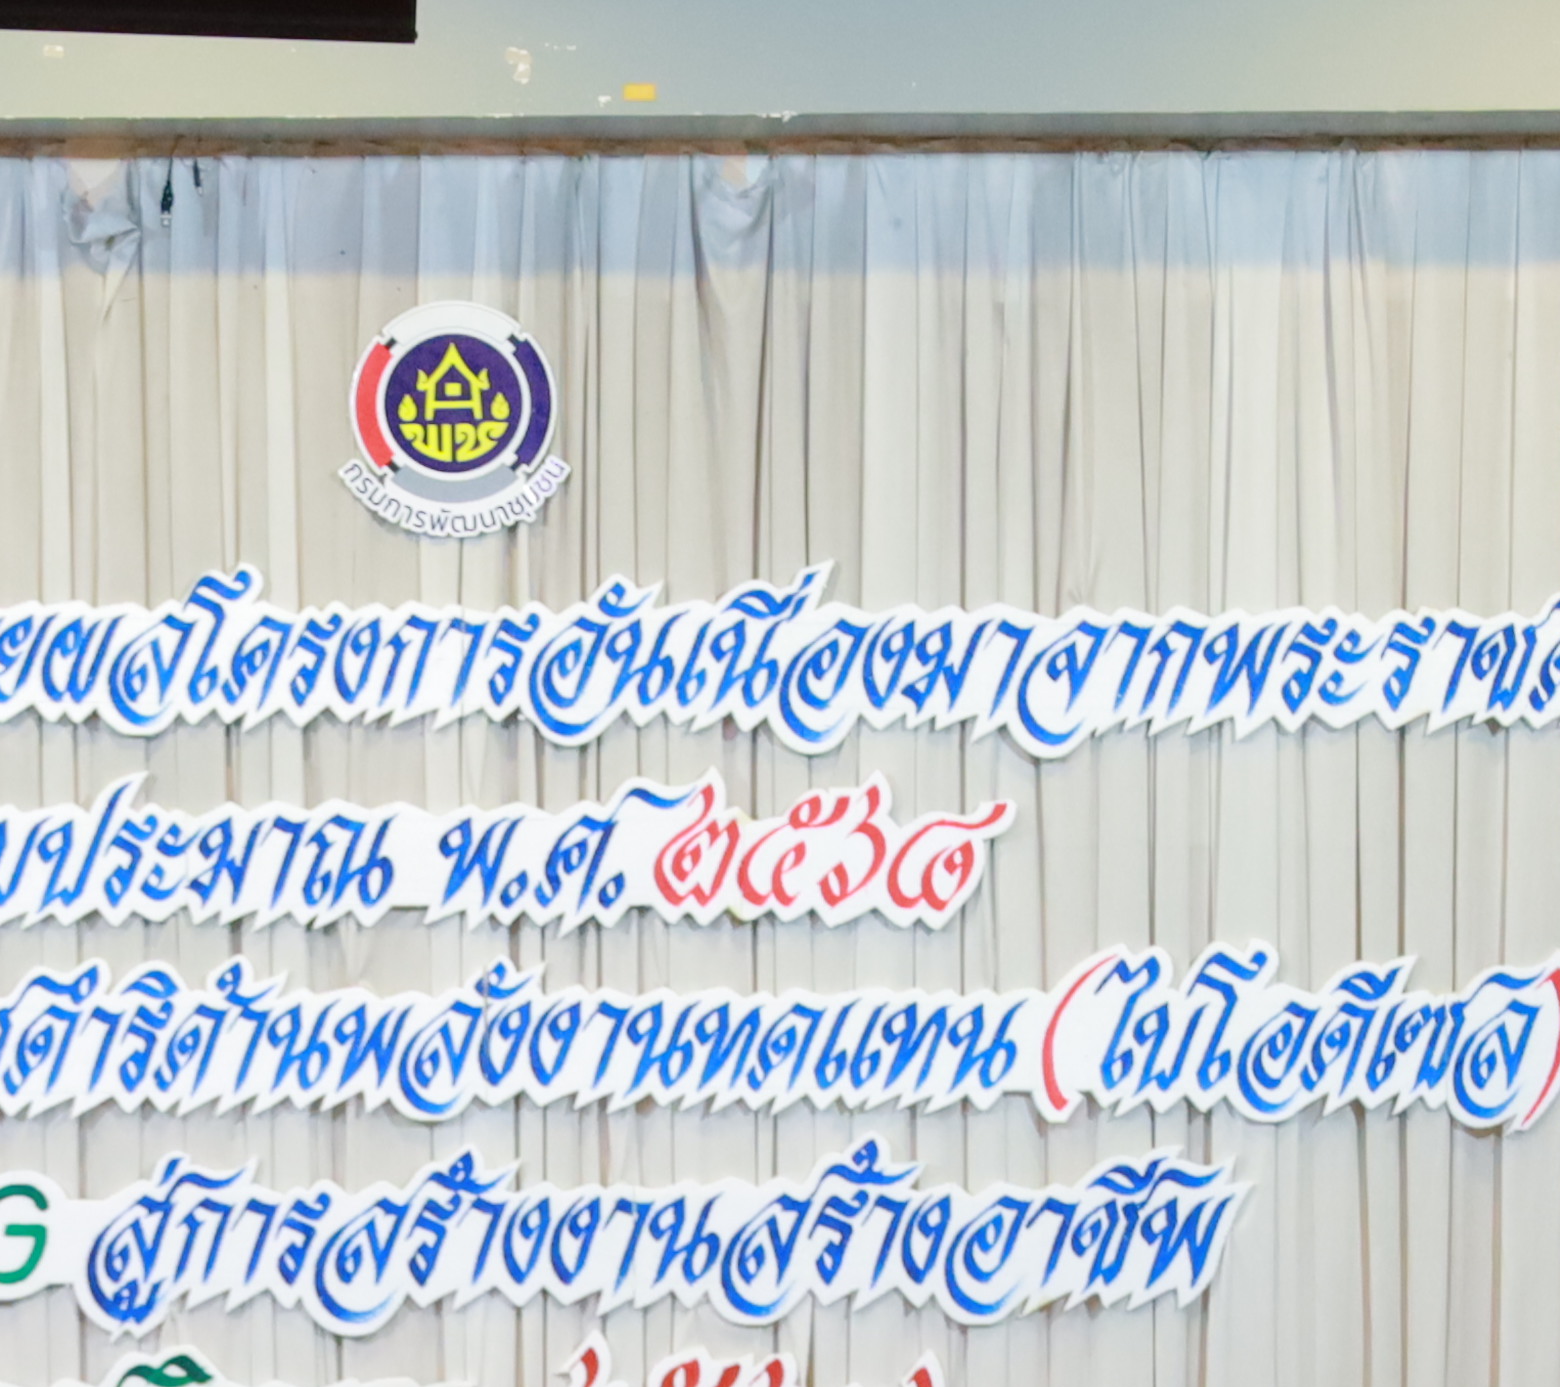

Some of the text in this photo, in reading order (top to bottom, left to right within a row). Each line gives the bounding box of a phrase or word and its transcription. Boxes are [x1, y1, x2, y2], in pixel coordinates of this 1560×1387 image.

[344, 458, 566, 534] กรมการพัฒนาชุมชน
[87, 1139, 1236, 1324] สู่การสร้างงานสร้างอาชีพ
